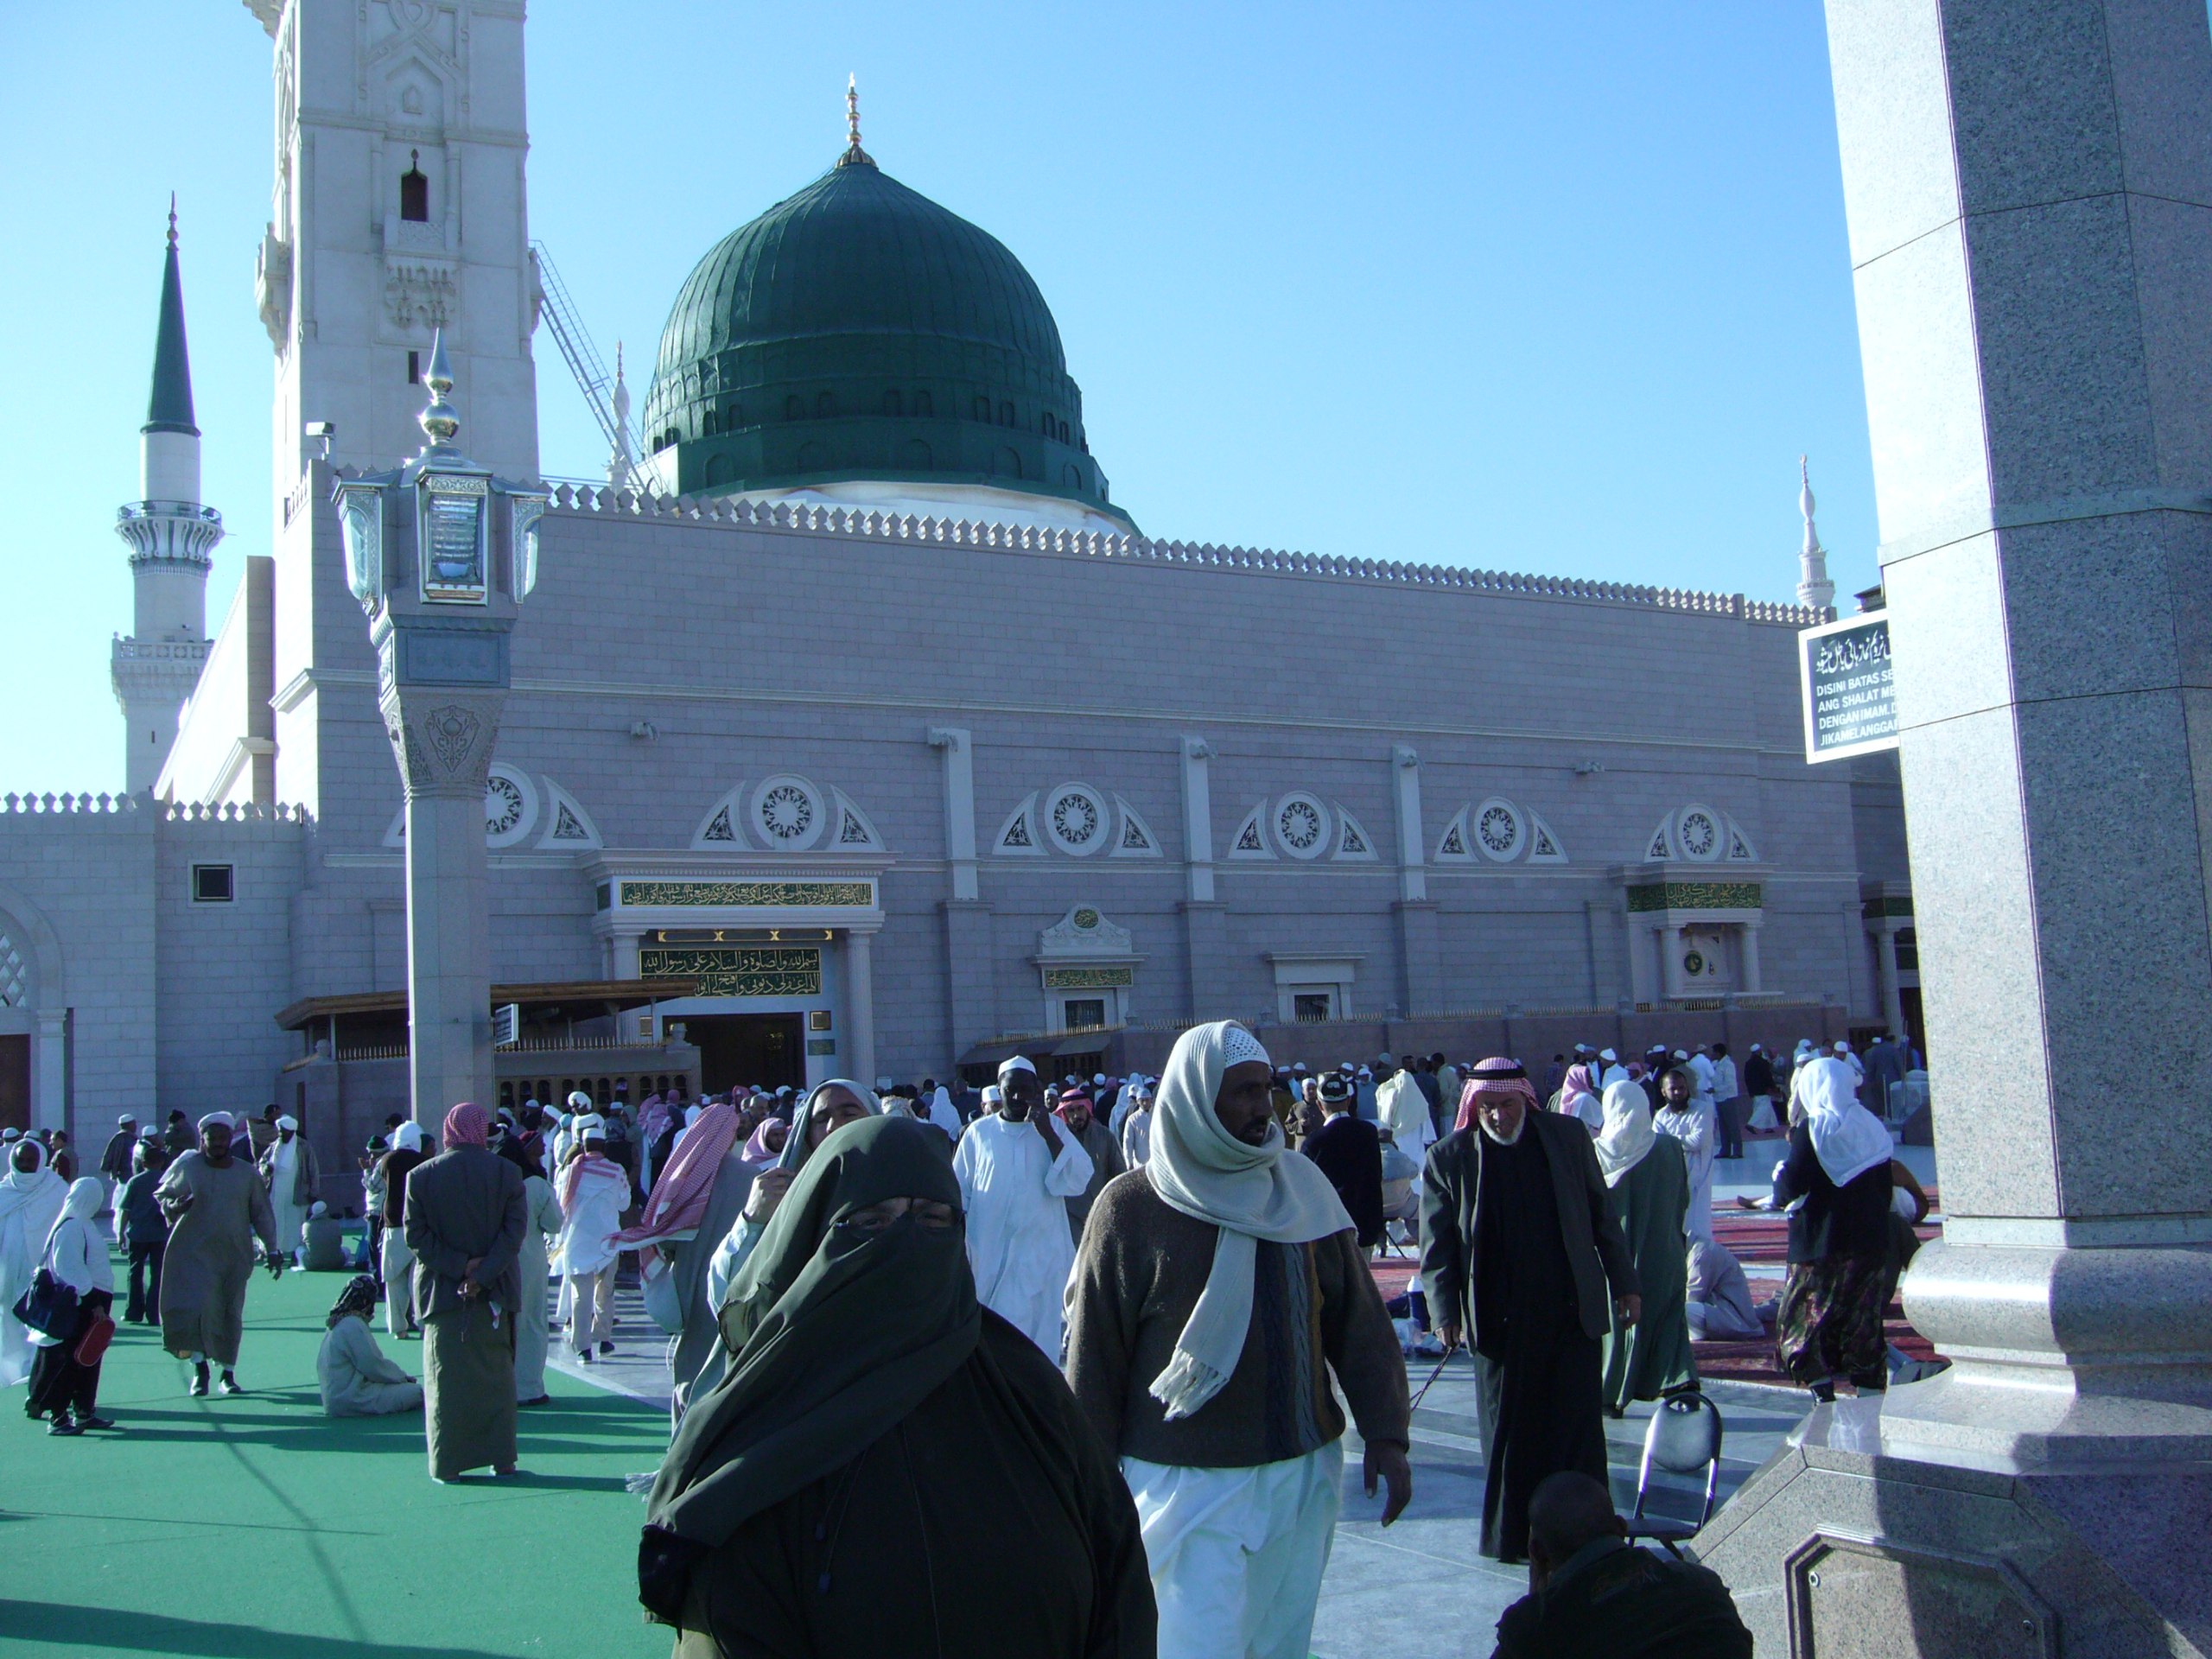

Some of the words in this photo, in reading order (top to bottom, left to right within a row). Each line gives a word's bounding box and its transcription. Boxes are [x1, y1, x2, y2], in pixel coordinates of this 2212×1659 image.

[1816, 680, 1847, 696] DISINI
[1848, 672, 1879, 690] BATAS
[1818, 698, 1840, 713] ANG
[1841, 689, 1879, 708] SHALAT
[1819, 709, 1859, 730] DENGAN
